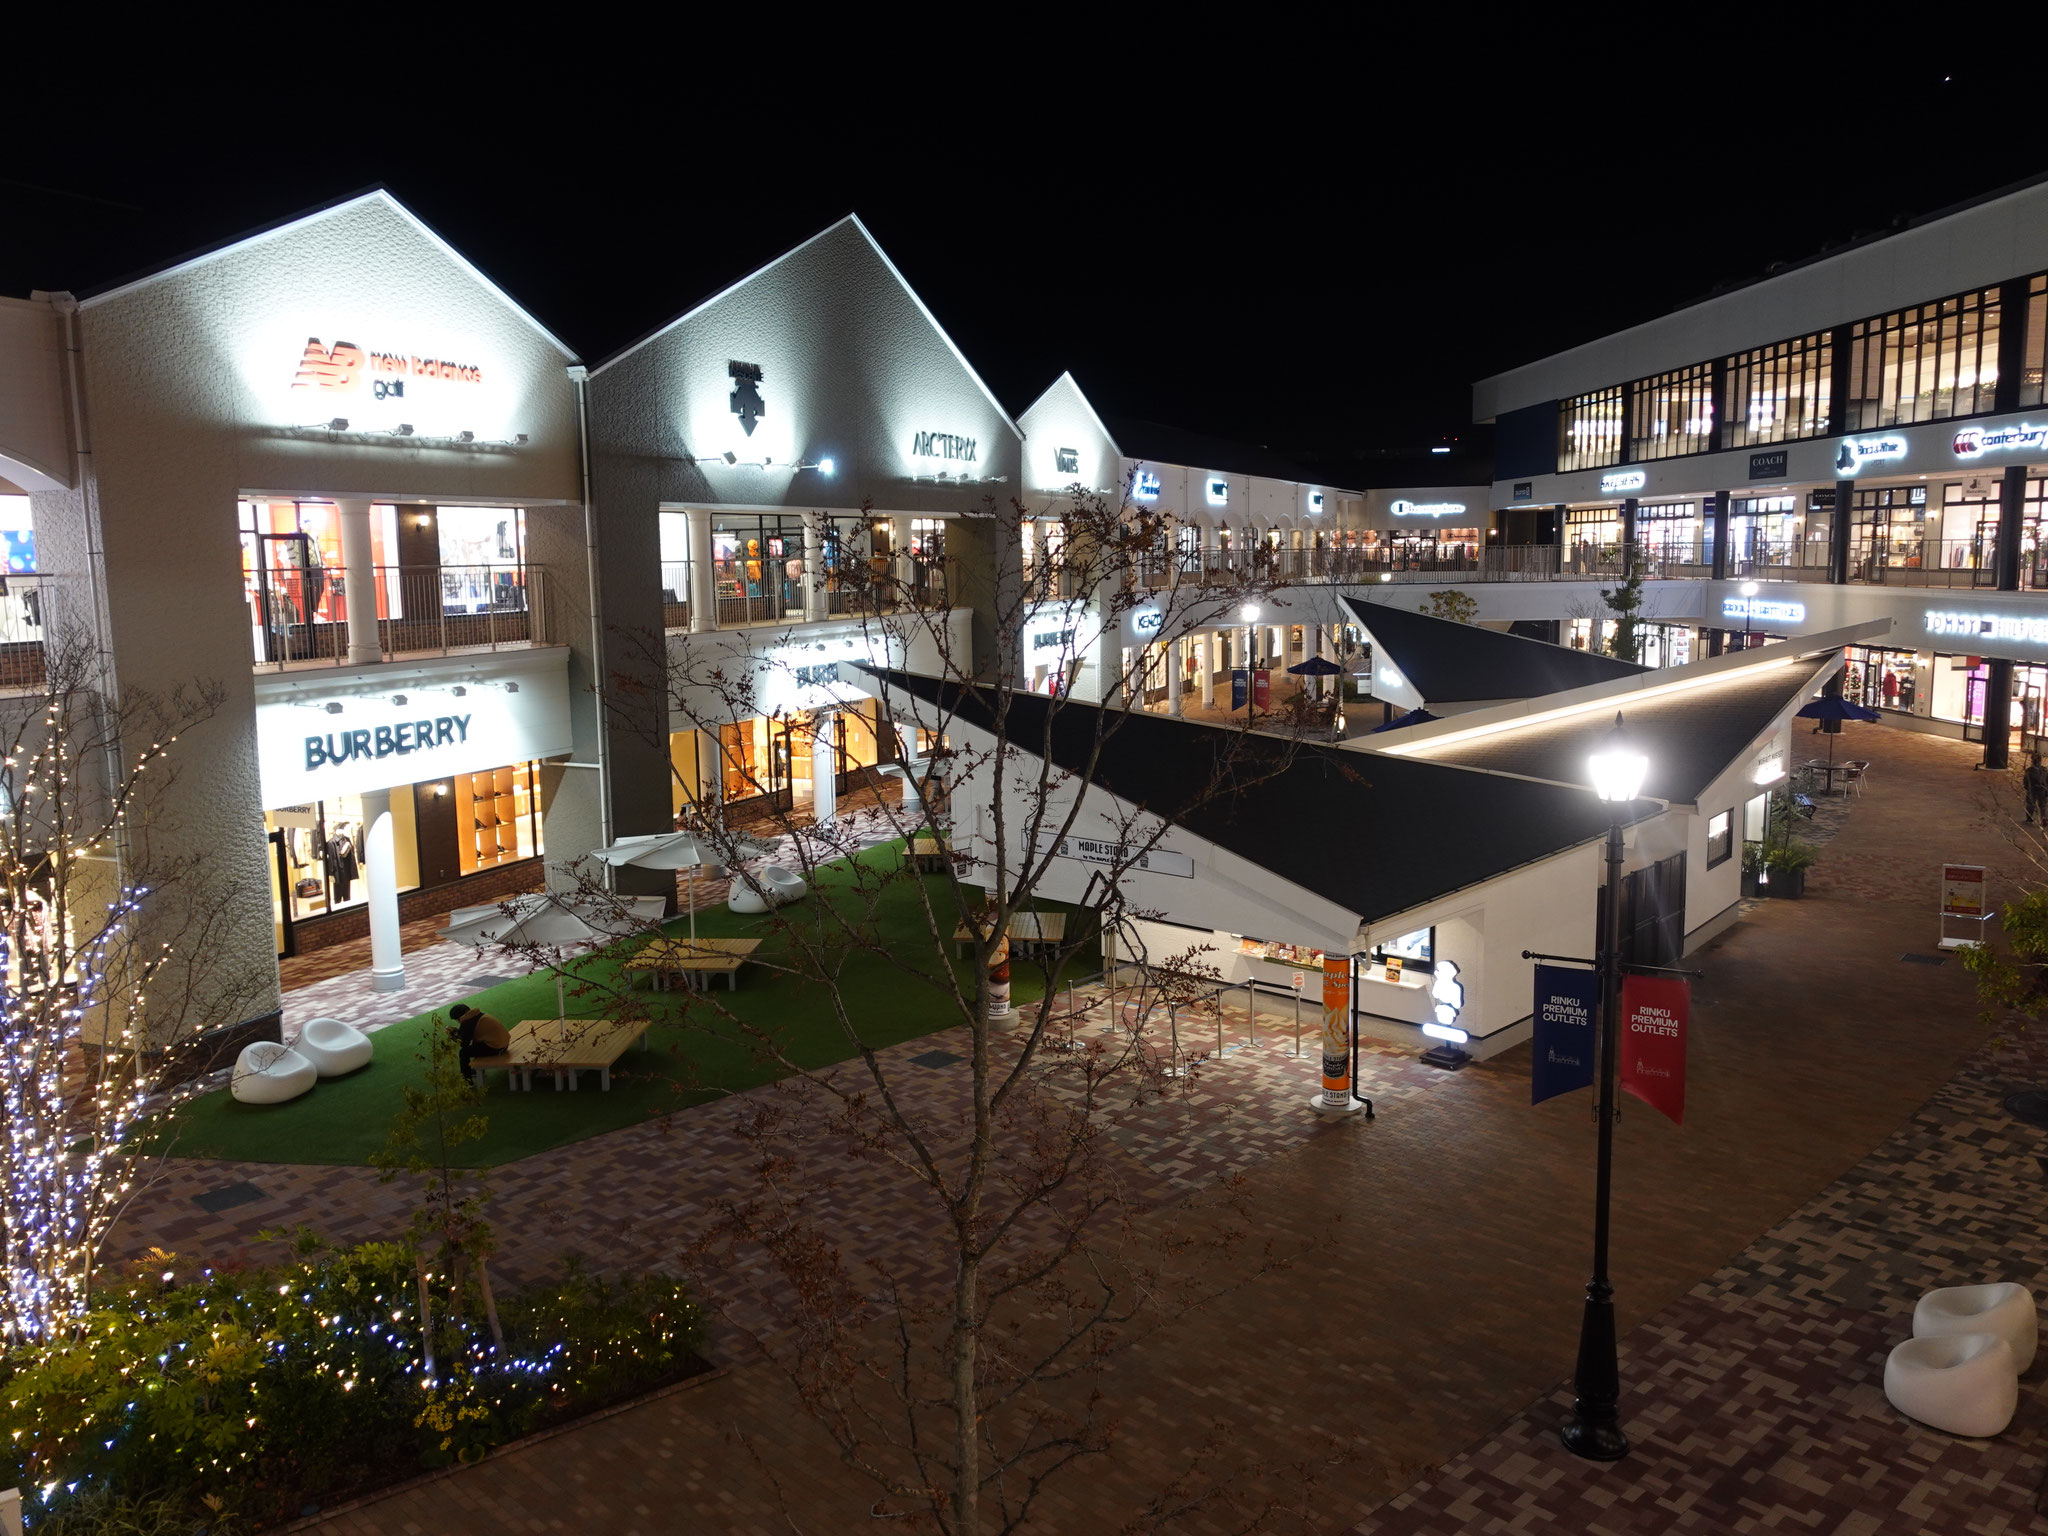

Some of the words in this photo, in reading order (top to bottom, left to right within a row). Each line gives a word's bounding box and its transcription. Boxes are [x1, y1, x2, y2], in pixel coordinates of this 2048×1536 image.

[370, 351, 408, 375] new
[411, 355, 483, 384] balance
[1981, 426, 2048, 447] canterbury
[1752, 455, 1784, 467] COACH
[1138, 613, 1162, 629] KENZO
[1924, 615, 1975, 634] TOMMY
[304, 713, 472, 772] BURBERRY
[1078, 840, 1103, 854] MAPLE
[1104, 844, 1129, 858] STAD
[1550, 995, 1580, 1007] RINKU
[1542, 1003, 1588, 1017] PREMIUM
[1639, 1006, 1671, 1018] RINKU
[1542, 1012, 1587, 1026] OUTLETS
[1631, 1014, 1679, 1028] PREMIUM
[1631, 1023, 1678, 1038] OUTLETS
